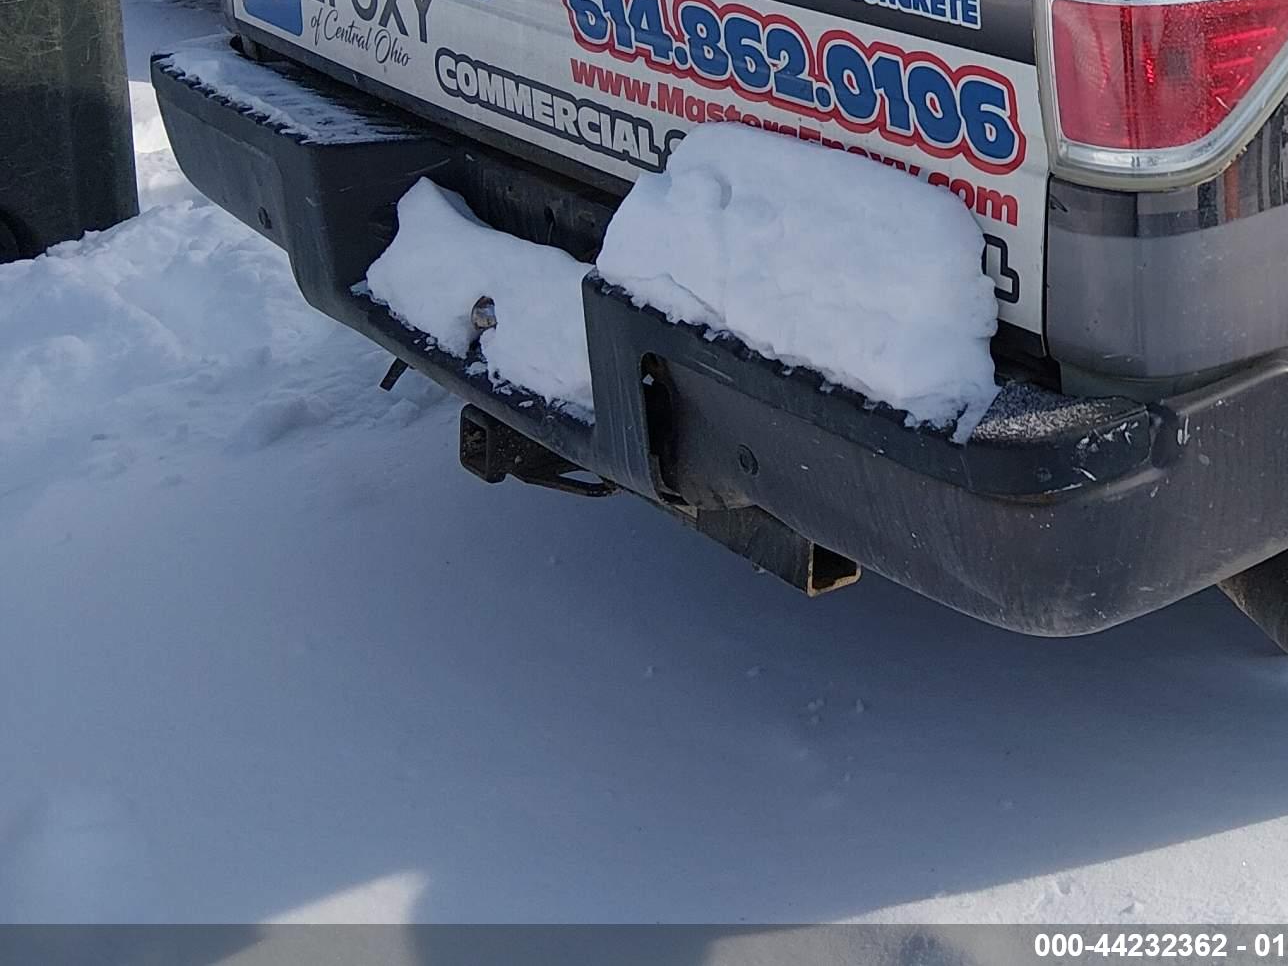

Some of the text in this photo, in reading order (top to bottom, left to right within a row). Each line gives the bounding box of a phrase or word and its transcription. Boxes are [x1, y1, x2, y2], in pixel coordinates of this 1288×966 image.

[309, 8, 413, 68] of Central Ohio
[436, 48, 665, 172] COMMERCIAL
